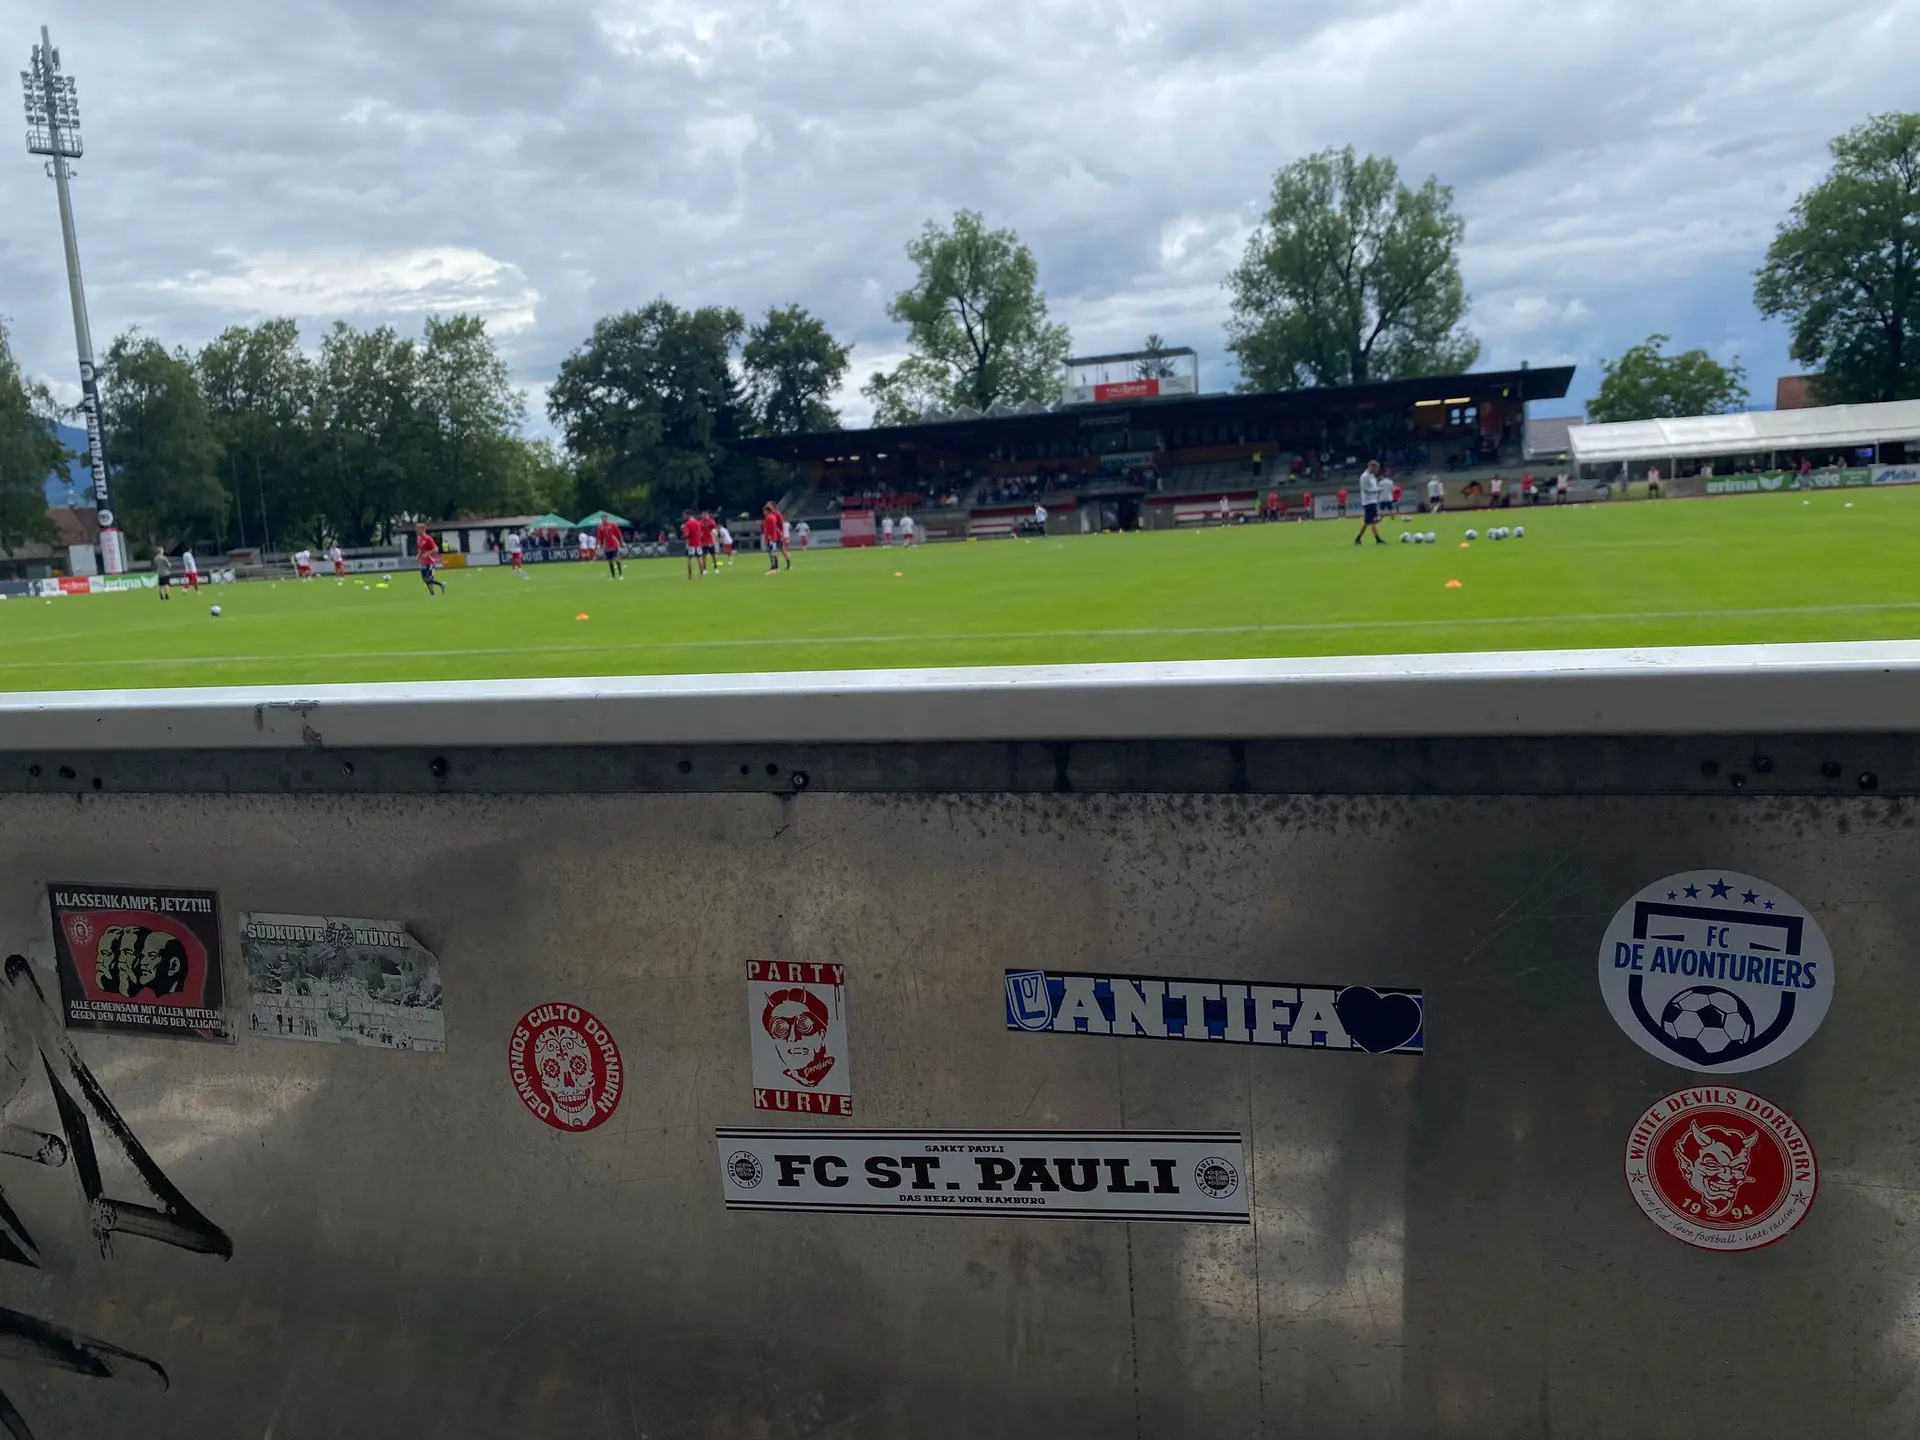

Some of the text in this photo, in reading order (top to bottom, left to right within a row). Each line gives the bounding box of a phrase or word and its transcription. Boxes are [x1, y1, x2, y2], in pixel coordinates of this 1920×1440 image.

[1706, 478, 1758, 493] erima
[160, 897, 212, 913] JETZT!!!
[247, 921, 326, 943] SÜDKURVE
[1707, 926, 1730, 949] FC
[747, 961, 844, 984] PARTY
[1614, 942, 1817, 990] DE AVONTURIERS
[70, 1000, 221, 1019] ALLE GEMEINSAM MIT ALLEN MITTELN
[71, 1010, 96, 1020] GEGEN
[98, 1011, 114, 1021] DEN
[116, 1013, 150, 1024] ABSTIEG
[152, 1015, 169, 1026] AUS
[170, 1017, 187, 1028] DER
[1053, 976, 1352, 1048] ANTIFA
[511, 1005, 620, 1119] DEMONIOS CULTO DORNBIRN
[755, 1089, 852, 1115] KURVE
[1630, 1090, 1811, 1182] WHITE DEVILS DORNBIRN
[924, 1145, 1004, 1153] SANKT PAULI
[774, 1154, 1180, 1195] FC ST. PAULI
[898, 1194, 1046, 1206] DAS HERZ VON HAMBURG
[1673, 1222, 1694, 1237] love
[1693, 1231, 1736, 1244] football
[1745, 1230, 1768, 1242] hate
